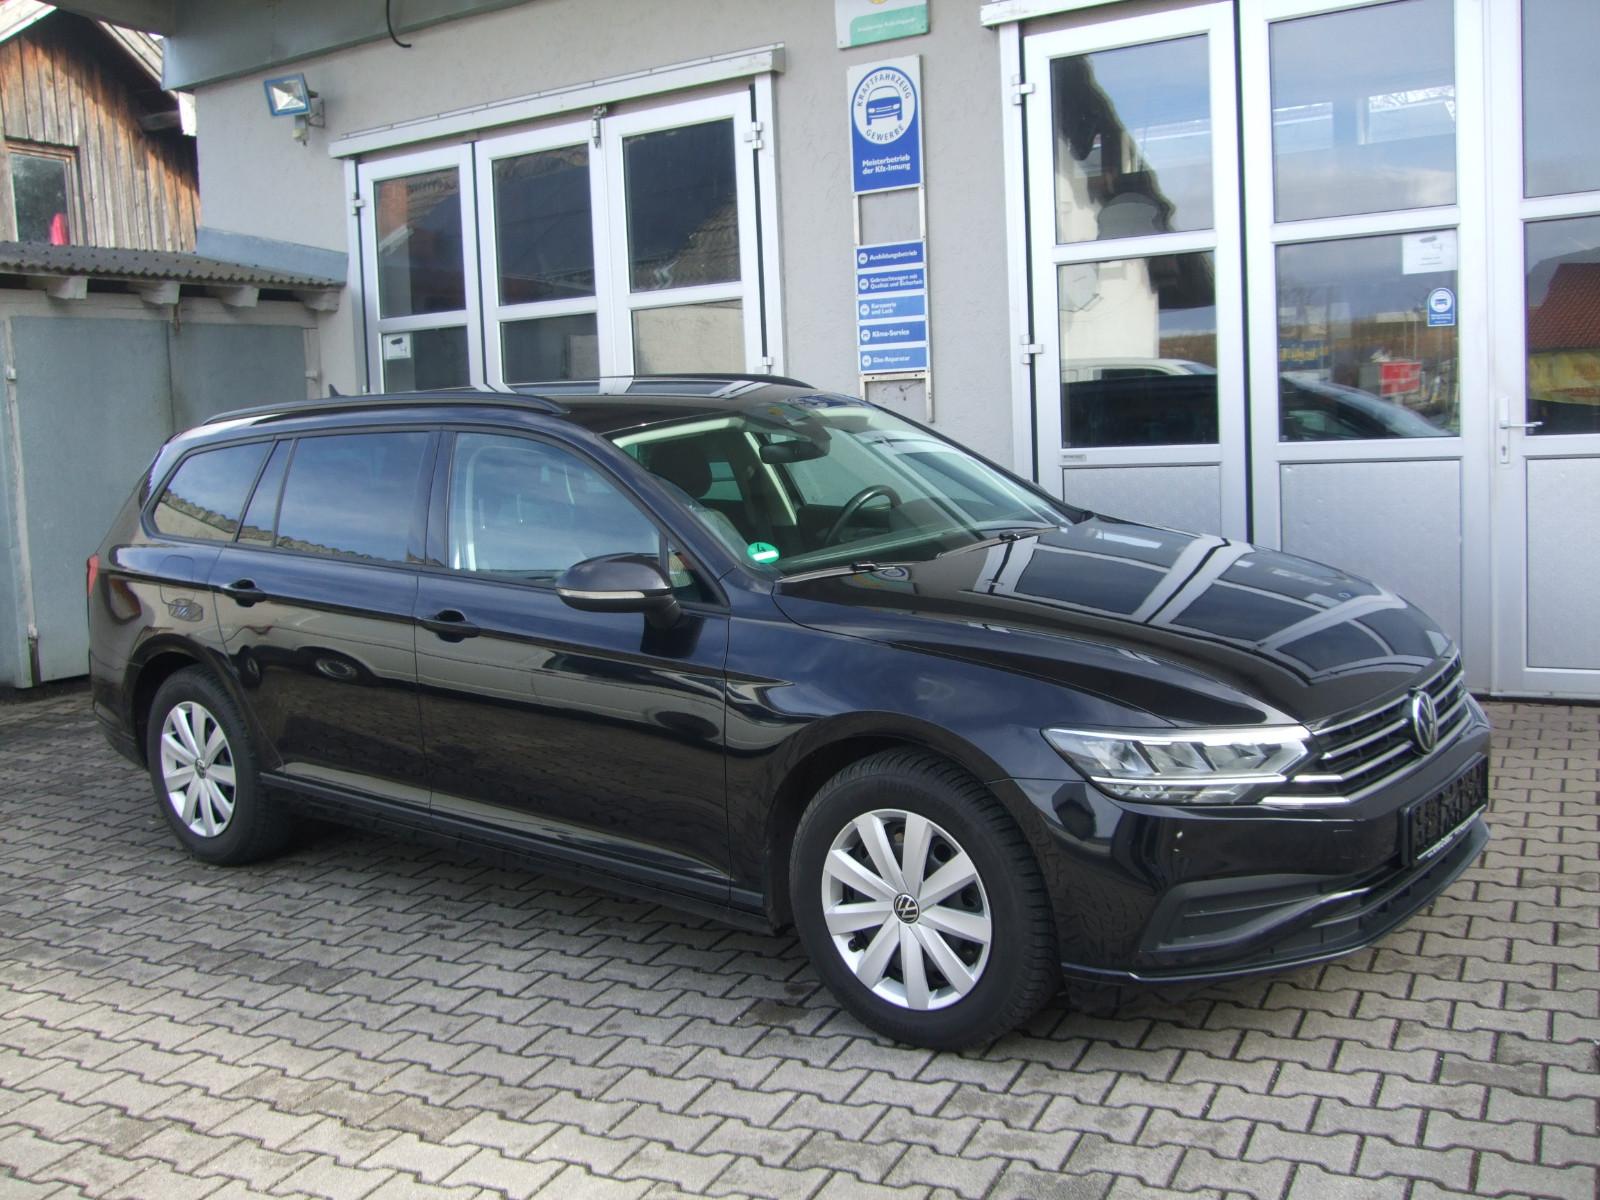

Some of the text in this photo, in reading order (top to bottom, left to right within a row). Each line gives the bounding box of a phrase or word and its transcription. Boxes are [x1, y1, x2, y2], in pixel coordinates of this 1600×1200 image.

[857, 74, 911, 107] KRAFTFAHRZEUG
[865, 124, 904, 142] GEWERBE
[862, 154, 910, 167] Meisterbetrieb
[862, 163, 911, 175] der Kfz-Innung
[870, 250, 917, 261] Ausbildungsbetrieb
[872, 329, 910, 337] Klima-Service
